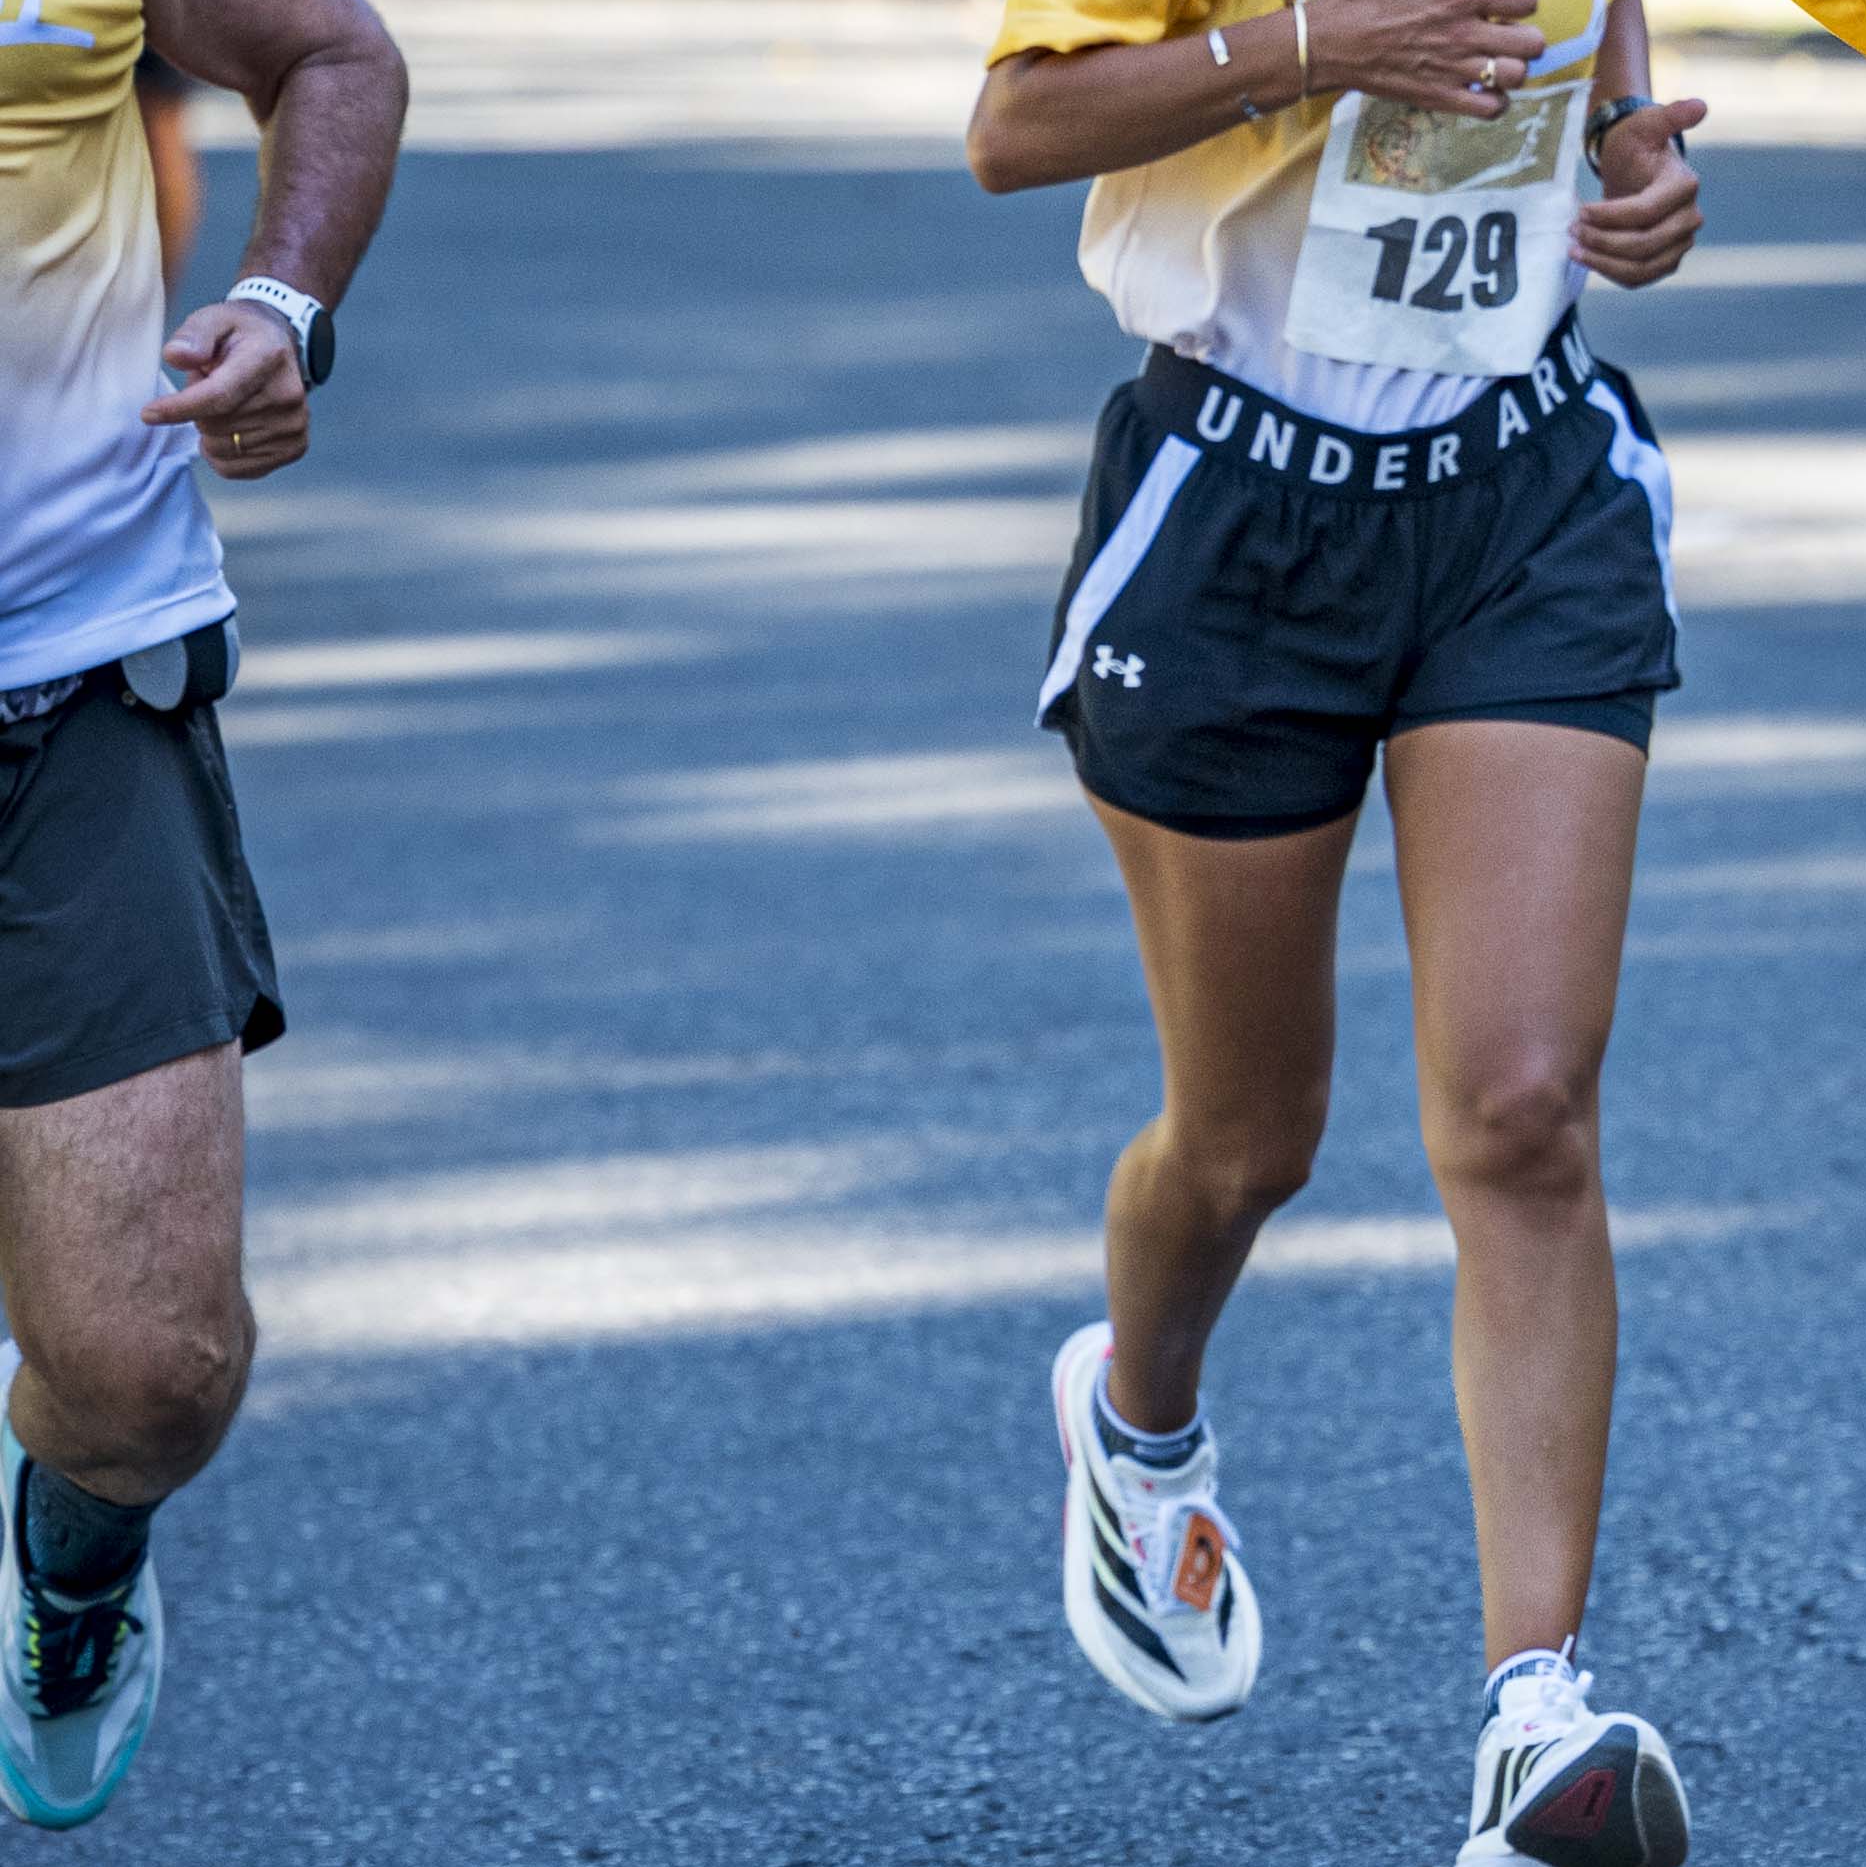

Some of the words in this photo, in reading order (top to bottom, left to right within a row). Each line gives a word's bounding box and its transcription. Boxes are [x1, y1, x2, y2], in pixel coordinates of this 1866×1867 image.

[1366, 211, 1519, 313] 129
[1195, 384, 1463, 492] UNDER
[1497, 321, 1594, 450] ARM
